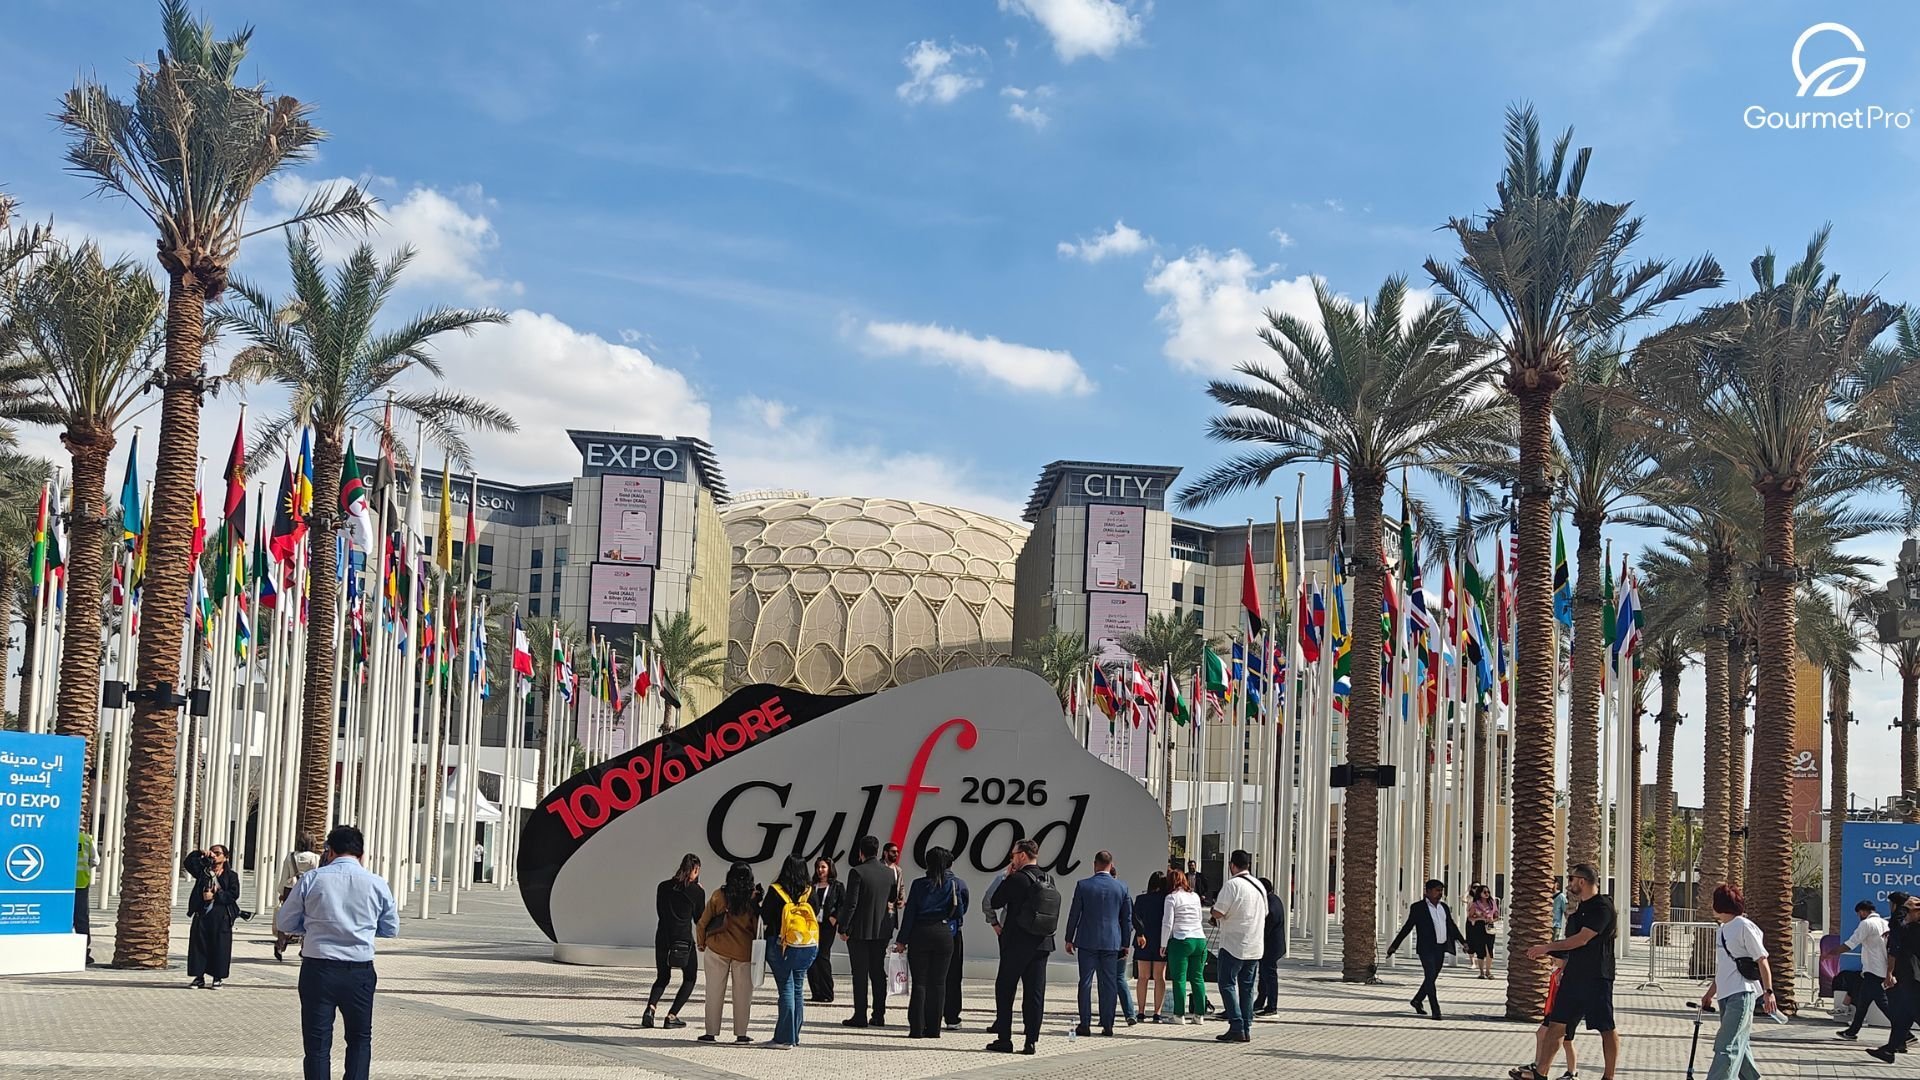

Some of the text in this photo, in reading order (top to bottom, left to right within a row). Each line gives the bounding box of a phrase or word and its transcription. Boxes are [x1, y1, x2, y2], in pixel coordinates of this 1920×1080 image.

[587, 442, 678, 471] EXPO
[1084, 473, 1153, 499] CITY
[448, 490, 515, 512] MASON
[0, 751, 63, 772] إلى مدينة
[546, 695, 792, 839] 100% MORE
[10, 771, 51, 788] إكسبو
[20, 793, 60, 809] EXPO
[706, 716, 1090, 877] Gulfood
[960, 777, 1048, 807] 2026
[10, 813, 45, 828] CITY
[1863, 839, 1899, 852] مدينة
[1873, 854, 1913, 869] إكسبو
[1862, 872, 1881, 885] TO
